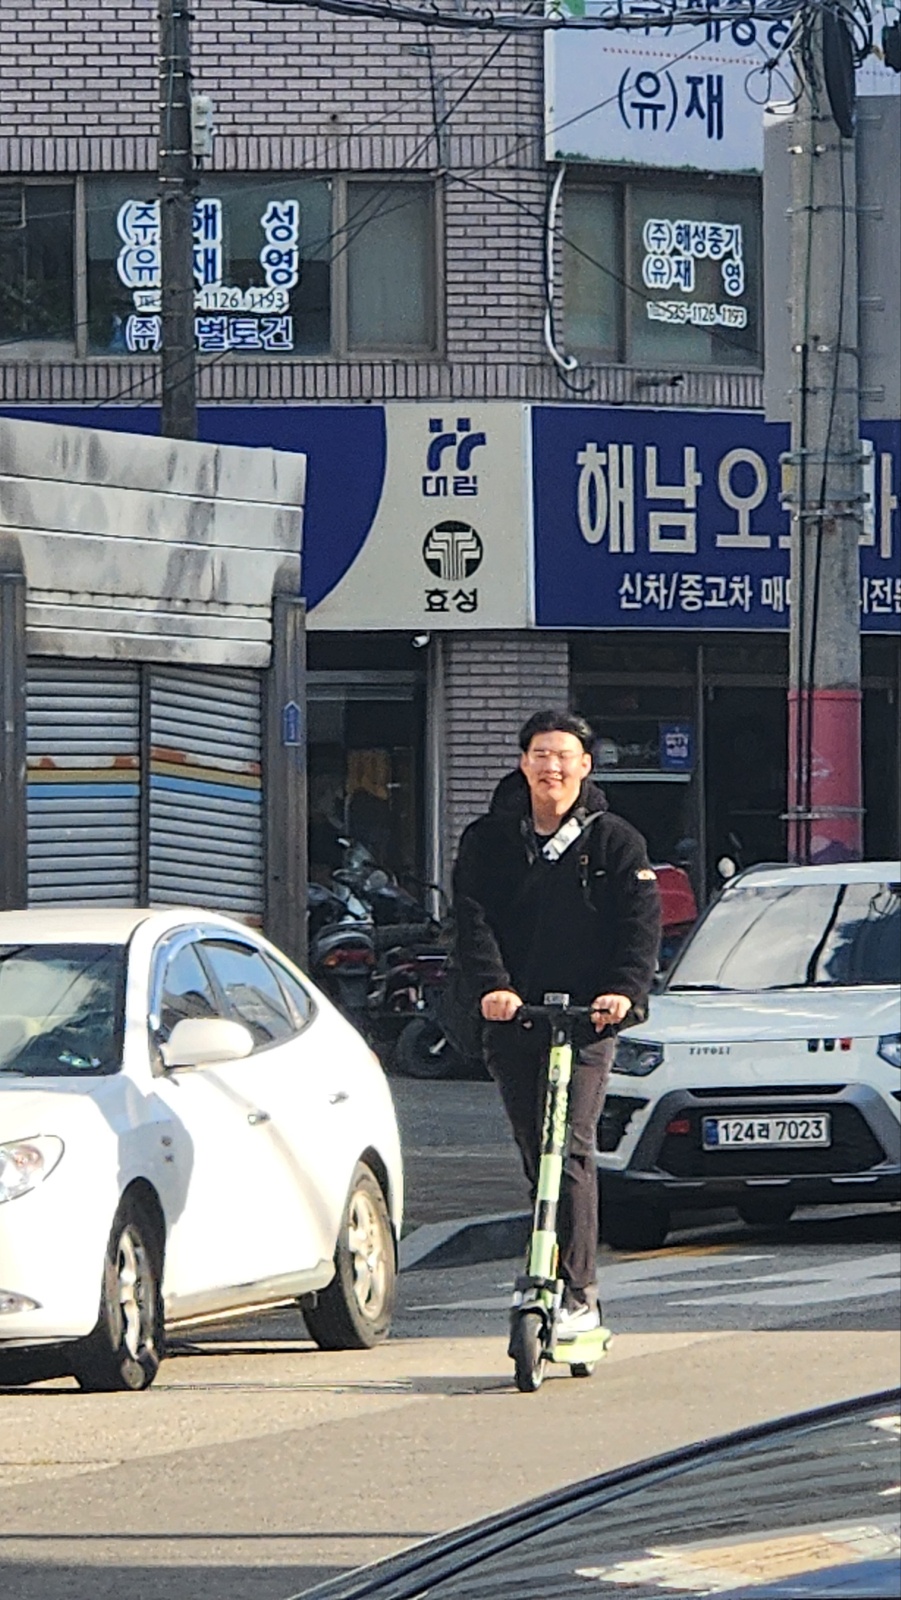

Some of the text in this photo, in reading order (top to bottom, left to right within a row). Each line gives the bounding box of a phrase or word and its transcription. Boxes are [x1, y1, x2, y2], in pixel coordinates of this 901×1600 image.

[618, 66, 724, 141] (유)재
[117, 200, 161, 246] (주
[260, 200, 299, 242] 성
[643, 219, 741, 259] (주)해성중기
[117, 245, 161, 287] (유
[260, 244, 299, 290] 영
[643, 254, 744, 296] (유)재 영
[126, 316, 293, 350] (주)별토건
[422, 475, 478, 497] 대림
[424, 588, 478, 613] 효성
[618, 572, 792, 612] 신차/중고차 매
[775, 1120, 823, 1140] 7023
